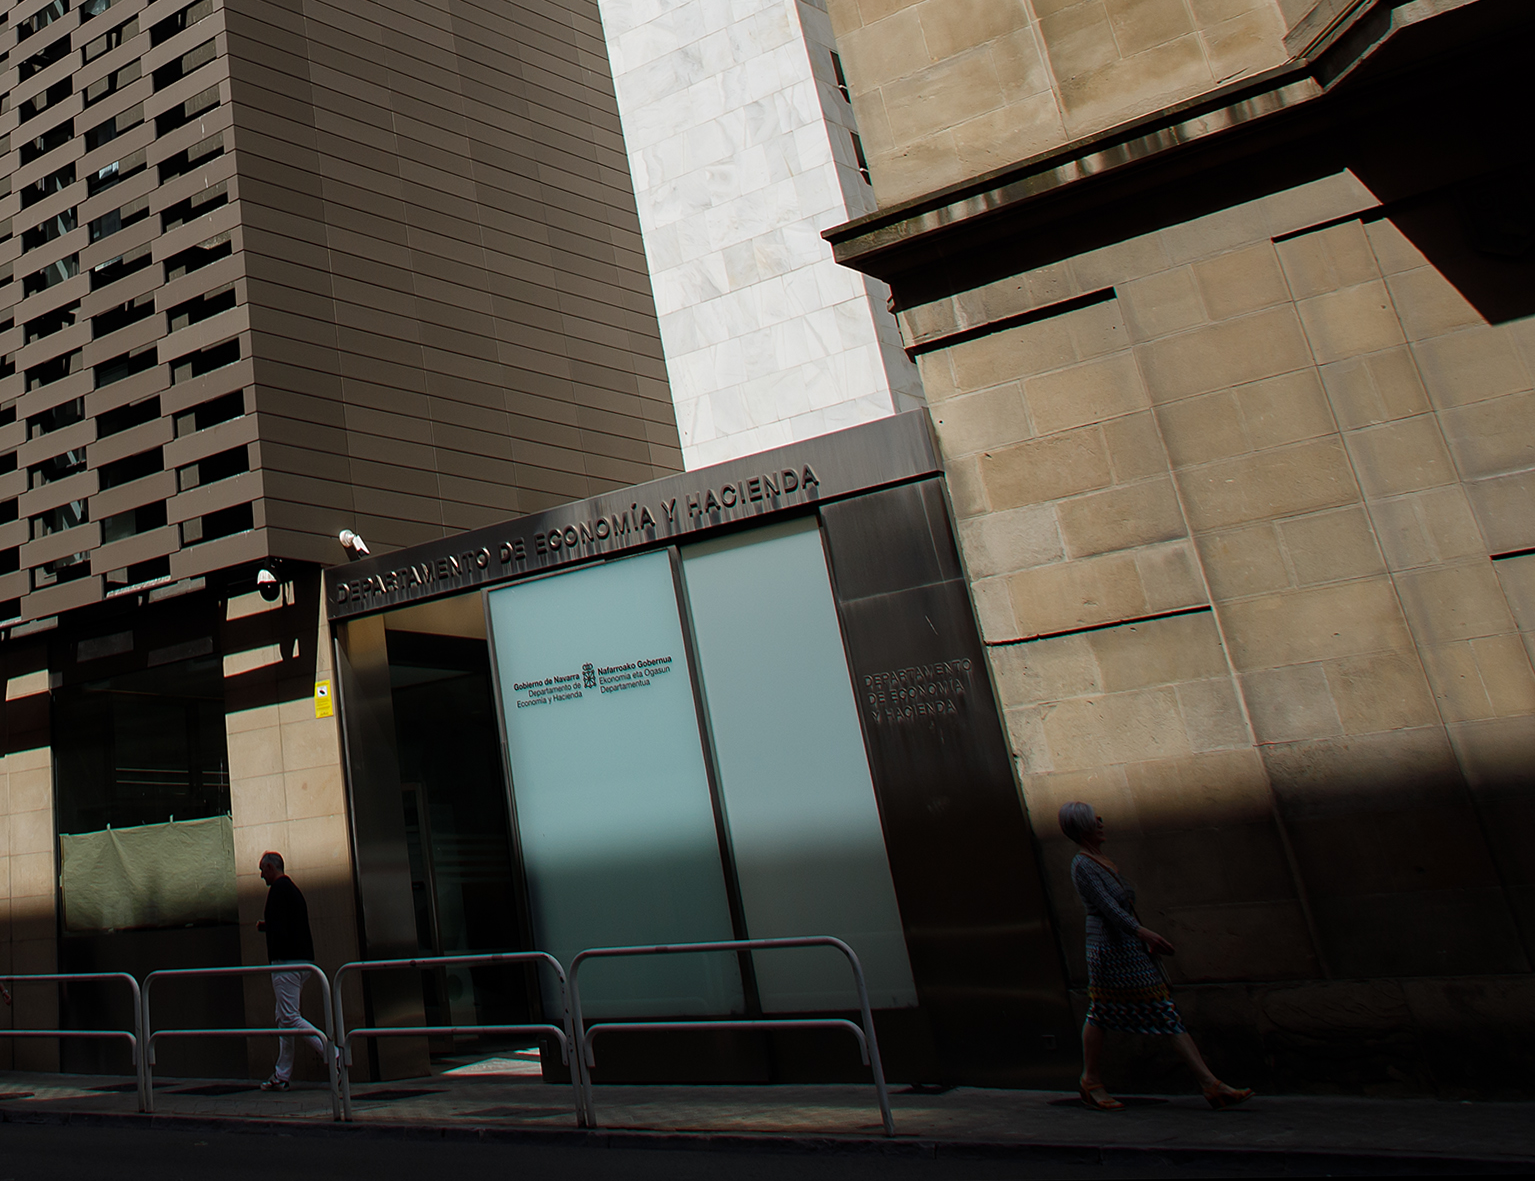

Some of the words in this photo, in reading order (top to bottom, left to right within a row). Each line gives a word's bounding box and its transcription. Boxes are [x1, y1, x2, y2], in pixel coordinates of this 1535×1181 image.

[337, 547, 491, 605] DEPARTAMENTO
[499, 537, 527, 565] DE
[533, 502, 656, 555] ECONOMÍA
[661, 498, 676, 523] Y
[685, 462, 820, 518] HACIENDA
[597, 662, 636, 676] Nafarroako
[636, 655, 673, 668] Gobernua
[632, 670, 644, 679] eta
[644, 665, 671, 678] Ogasun
[864, 658, 972, 688] DEPARTAMENTO
[513, 680, 543, 691] Gobierno
[544, 677, 553, 685] de
[553, 673, 580, 684] Navarra
[528, 684, 572, 698] Departamento
[572, 682, 582, 690] de
[600, 679, 651, 694] Departamentua
[553, 690, 583, 702] Hacienda
[868, 691, 886, 706] DE
[871, 710, 881, 723] Y
[885, 699, 957, 721] HACIENDA
